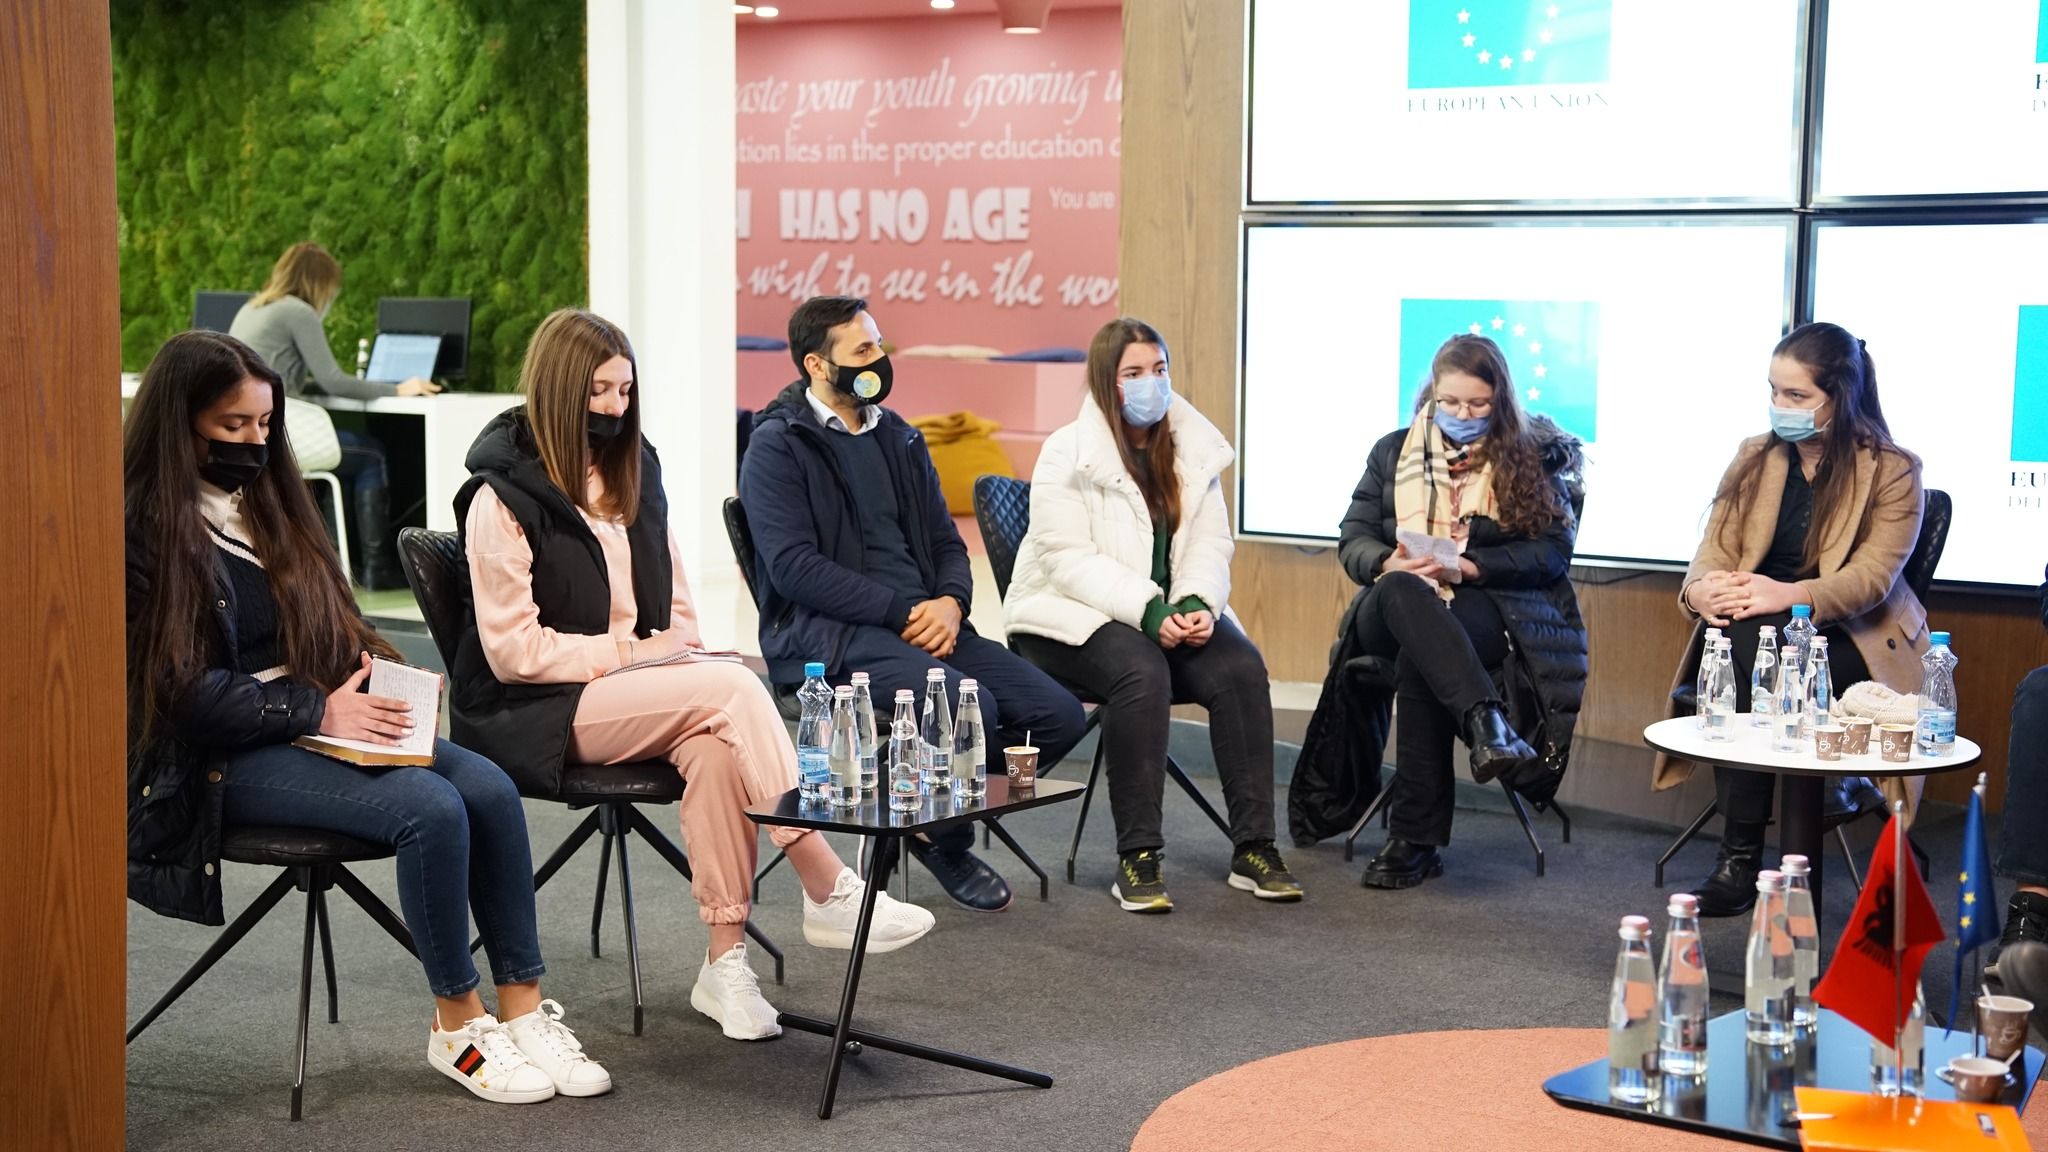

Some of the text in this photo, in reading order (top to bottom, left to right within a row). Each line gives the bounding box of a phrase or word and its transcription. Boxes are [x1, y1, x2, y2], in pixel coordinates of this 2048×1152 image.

[736, 75, 789, 114] aste
[790, 79, 865, 129] your
[865, 57, 956, 128] youth
[958, 61, 1097, 128] growing
[736, 135, 780, 163] tion
[784, 127, 821, 162] lies
[826, 134, 847, 162] in
[852, 126, 888, 161] the
[894, 139, 976, 177] proper
[979, 121, 1104, 160] education
[779, 188, 861, 240] HAS
[868, 187, 930, 243] NO
[941, 187, 1031, 243] AGE
[1049, 186, 1116, 209] You are
[747, 249, 1120, 308] wish to see in the wo
